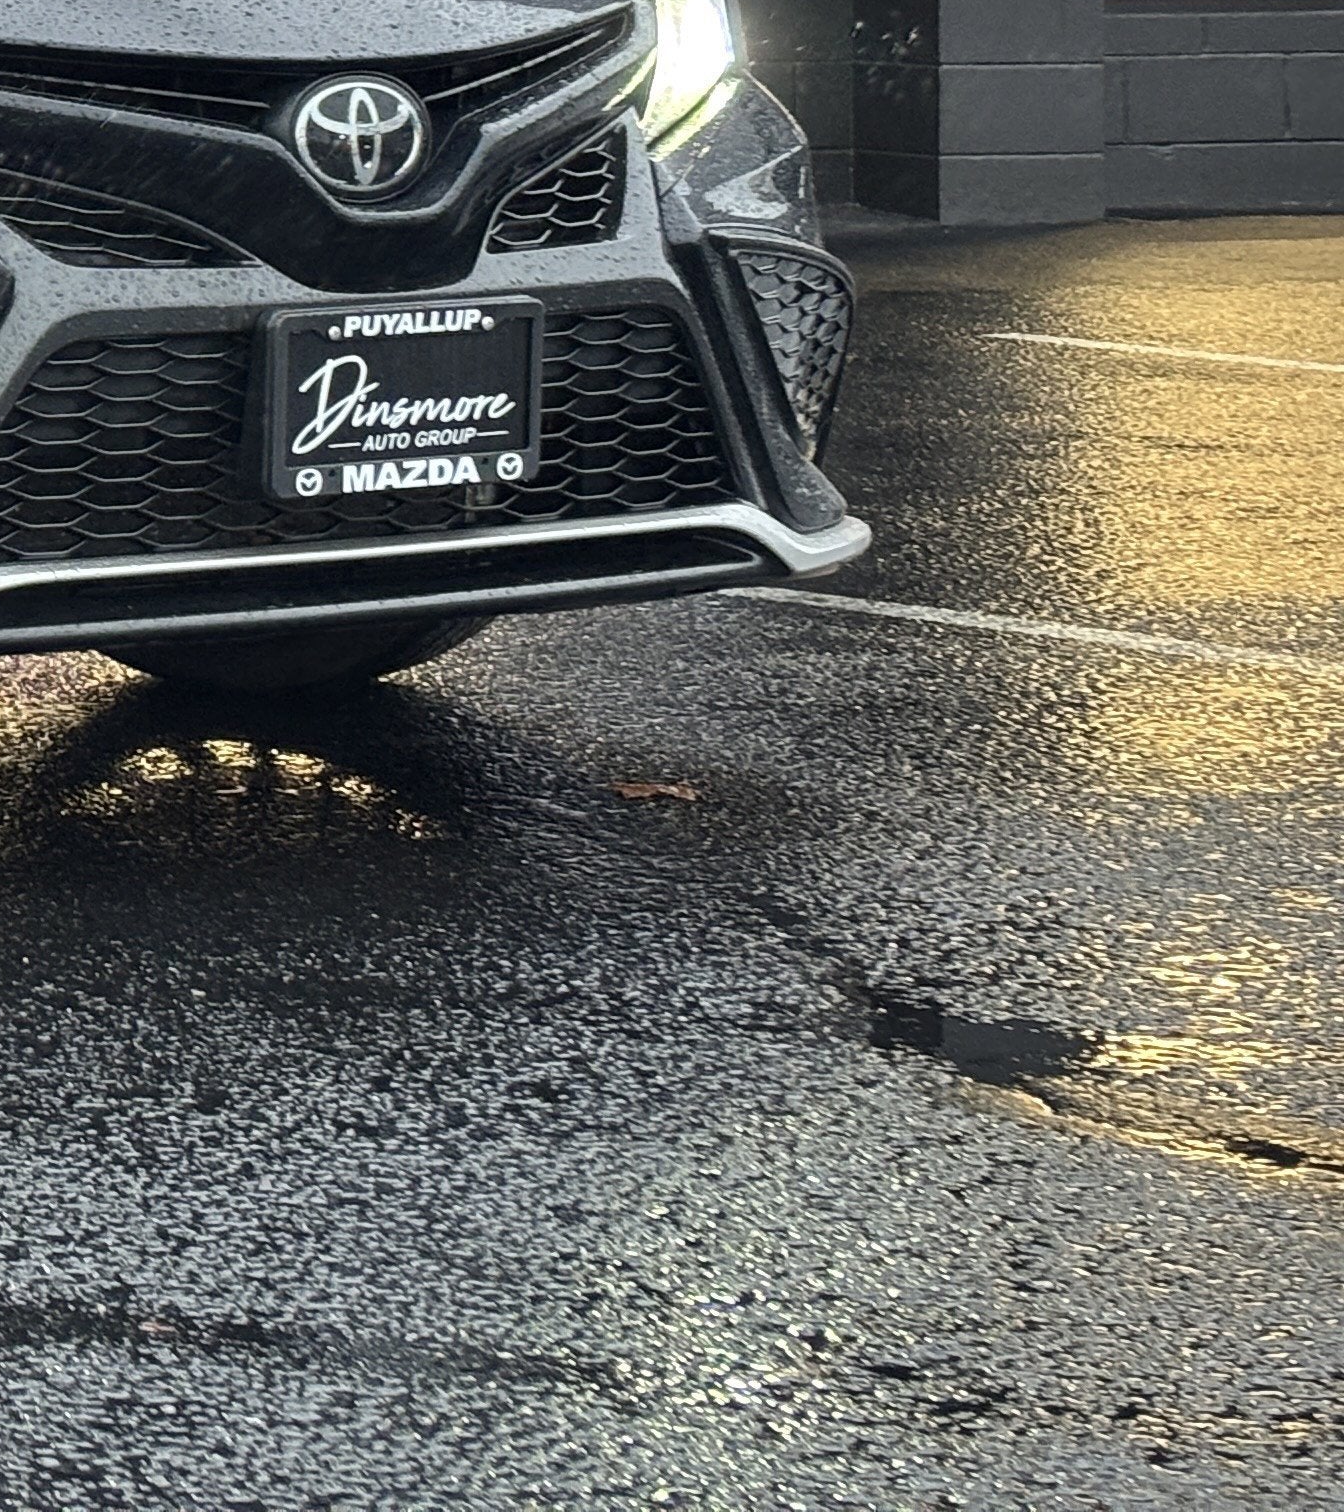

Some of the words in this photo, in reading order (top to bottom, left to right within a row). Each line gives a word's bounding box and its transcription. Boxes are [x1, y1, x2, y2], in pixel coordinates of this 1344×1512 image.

[342, 308, 482, 339] PUYALLUP
[291, 354, 517, 456] Dinsmore
[361, 431, 411, 452] AUTO
[414, 426, 478, 449] GROUP
[342, 456, 481, 494] MAZDA
